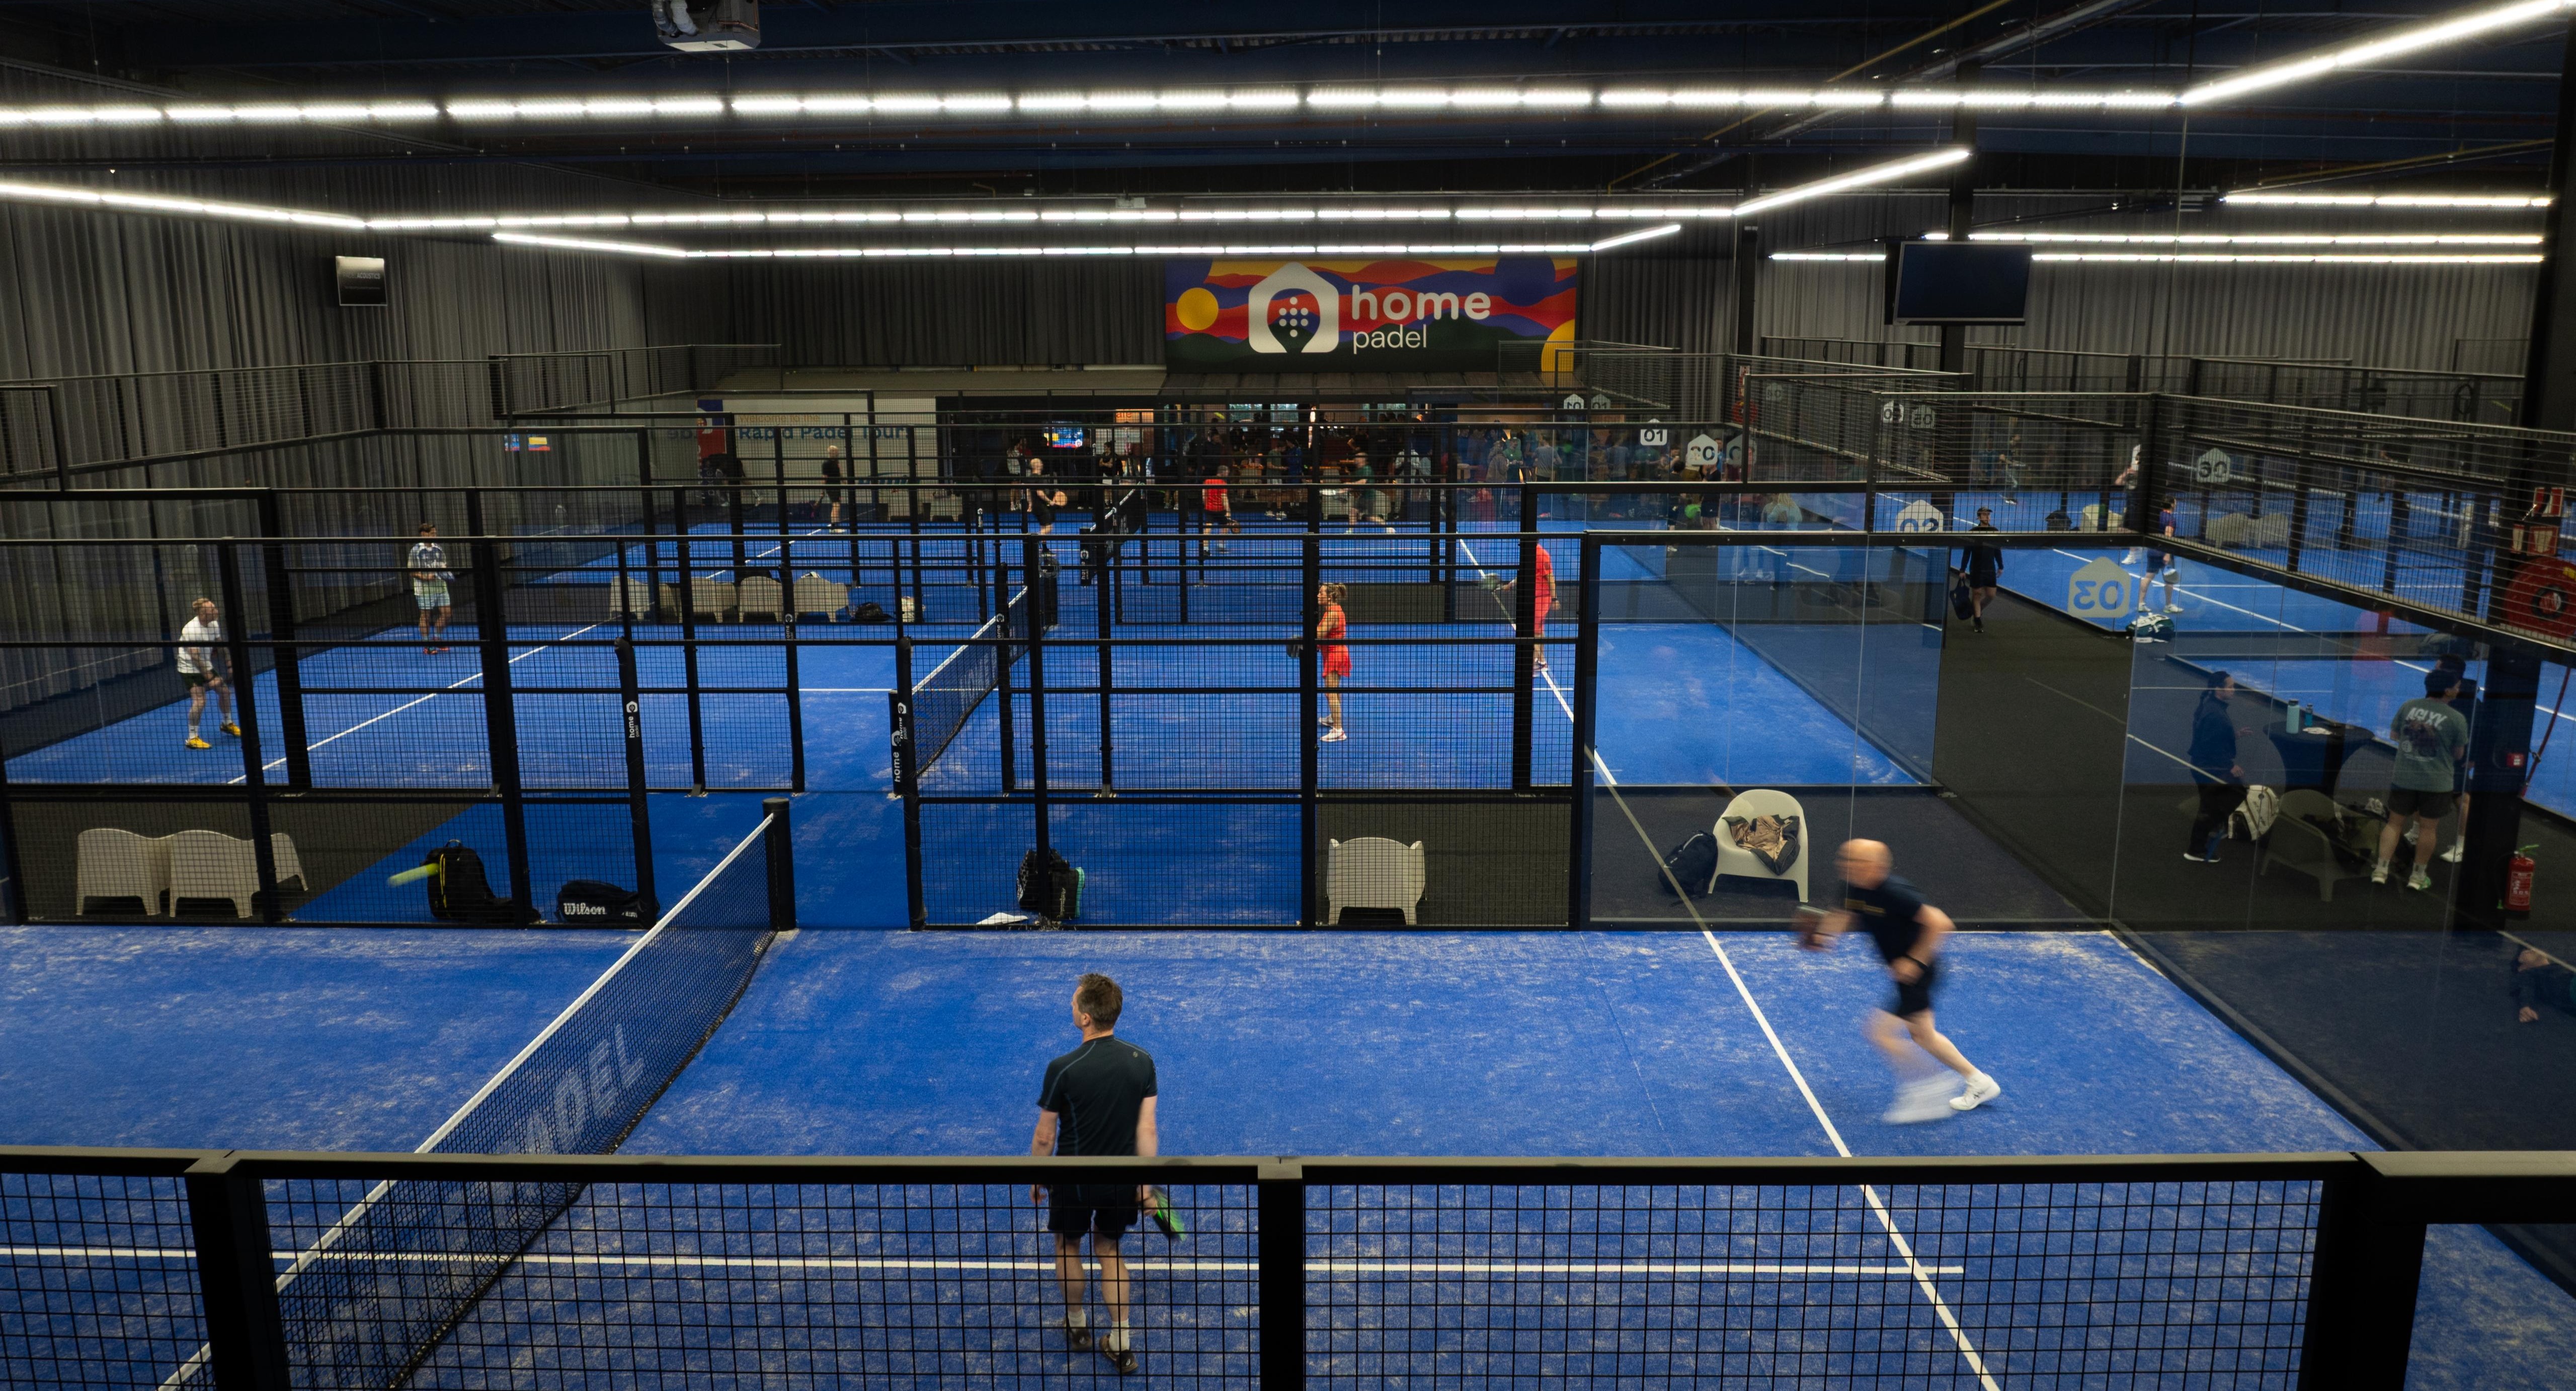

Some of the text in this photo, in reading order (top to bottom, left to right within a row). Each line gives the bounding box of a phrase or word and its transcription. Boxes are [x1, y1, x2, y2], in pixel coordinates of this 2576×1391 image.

[1352, 284, 1490, 320] home
[1353, 324, 1427, 354] padel
[740, 414, 786, 423] Welcome
[739, 426, 793, 441] Rapd
[800, 426, 853, 439] Pade
[1644, 429, 1663, 442] 01
[893, 751, 901, 783] home
[563, 902, 608, 916] Wilson
[498, 1023, 645, 1154] ADEL
